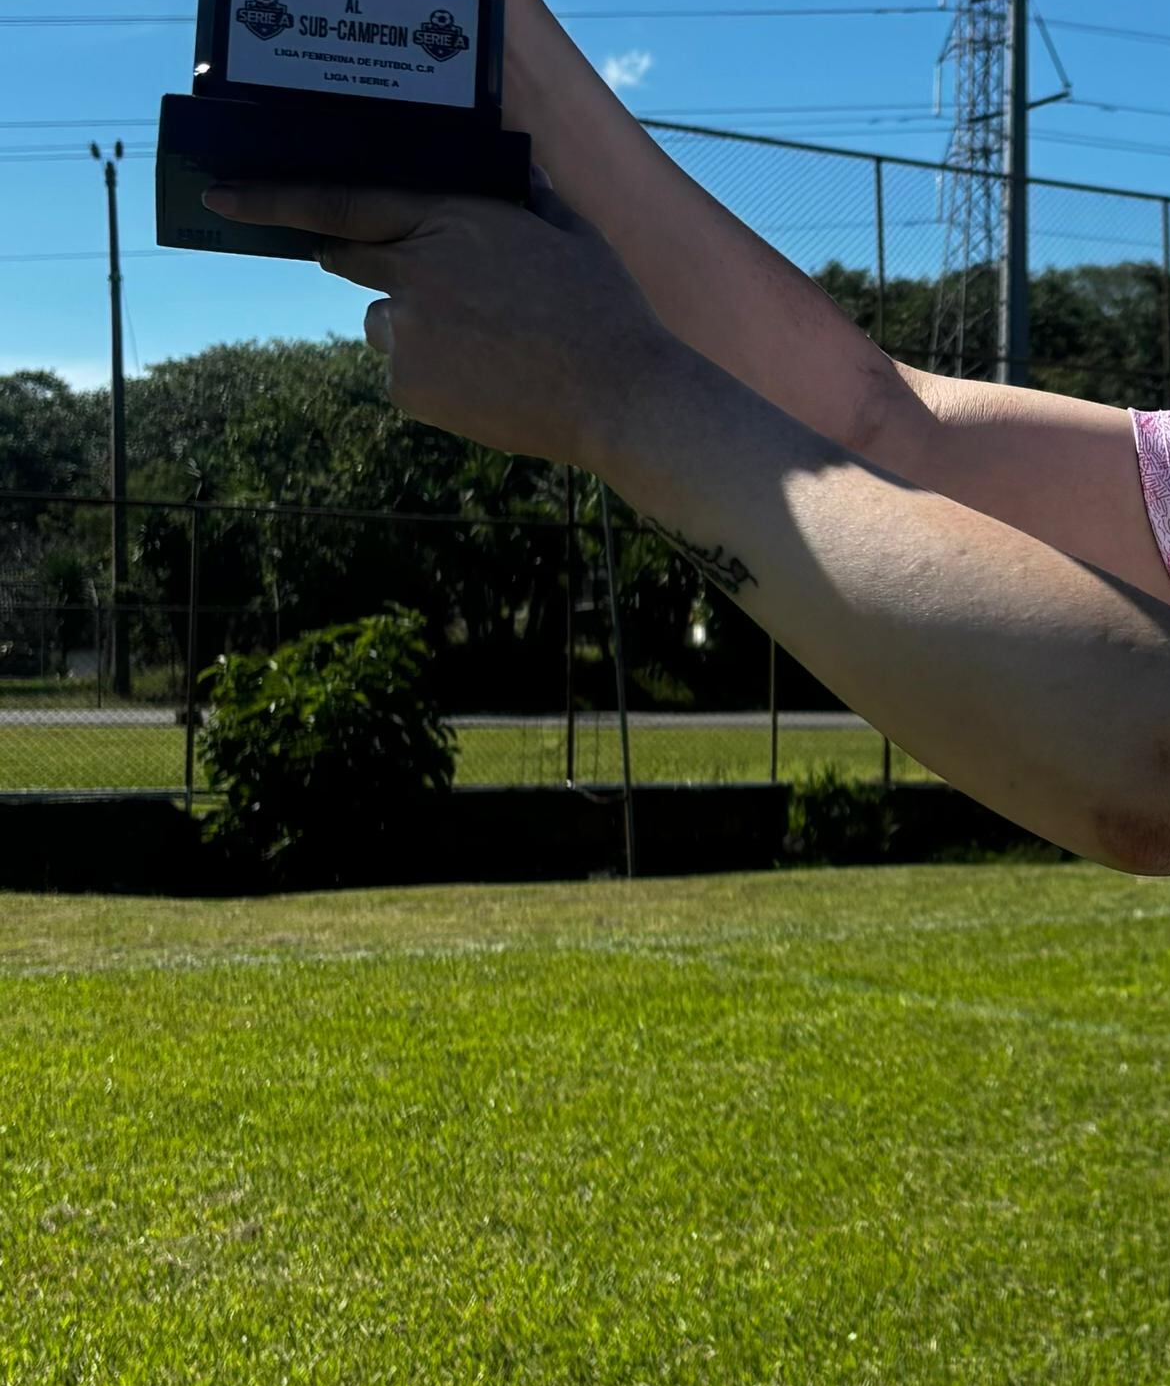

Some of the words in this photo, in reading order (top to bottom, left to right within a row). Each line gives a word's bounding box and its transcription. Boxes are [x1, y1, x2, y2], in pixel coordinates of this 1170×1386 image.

[240, 10, 279, 26] SERIE
[280, 14, 291, 27] A
[299, 14, 409, 48] SUB-CAMPEON
[415, 31, 453, 47] SERIE
[454, 34, 466, 48] A
[274, 47, 300, 58] LIGA
[302, 50, 356, 66] FEMENINA
[357, 57, 372, 67] DE
[373, 59, 415, 72] FUTBOL
[323, 72, 350, 83] LIGA
[359, 76, 390, 88] SERIE
[391, 79, 400, 88] A
